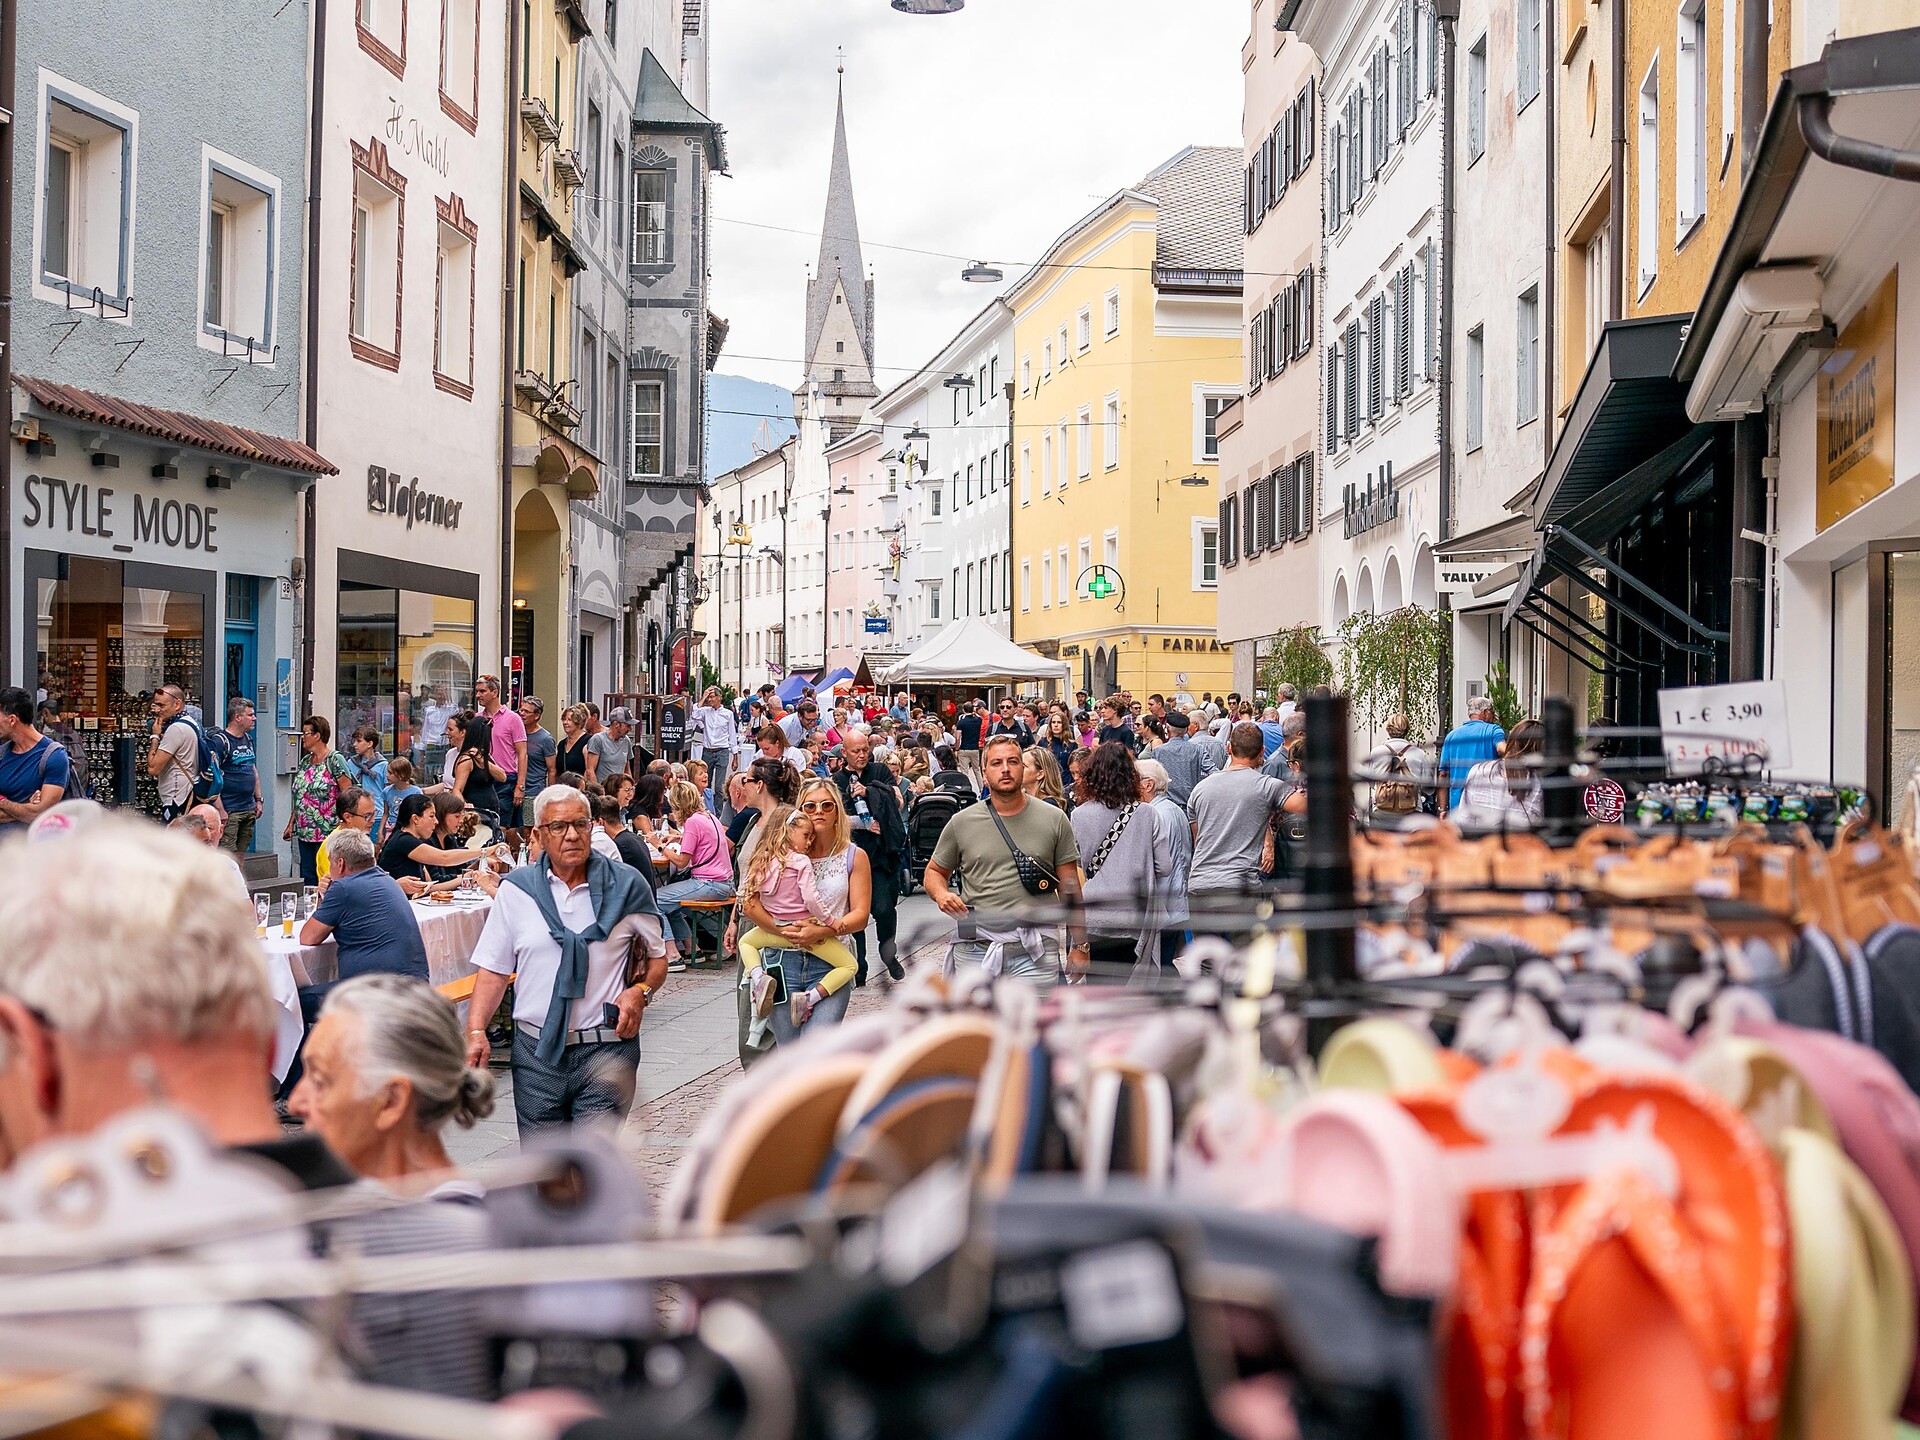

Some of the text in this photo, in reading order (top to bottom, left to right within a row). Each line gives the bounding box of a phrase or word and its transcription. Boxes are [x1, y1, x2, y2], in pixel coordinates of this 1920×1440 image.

[388, 472, 463, 531] Taferner
[1674, 710, 1682, 725] 1
[1701, 706, 1712, 722] €
